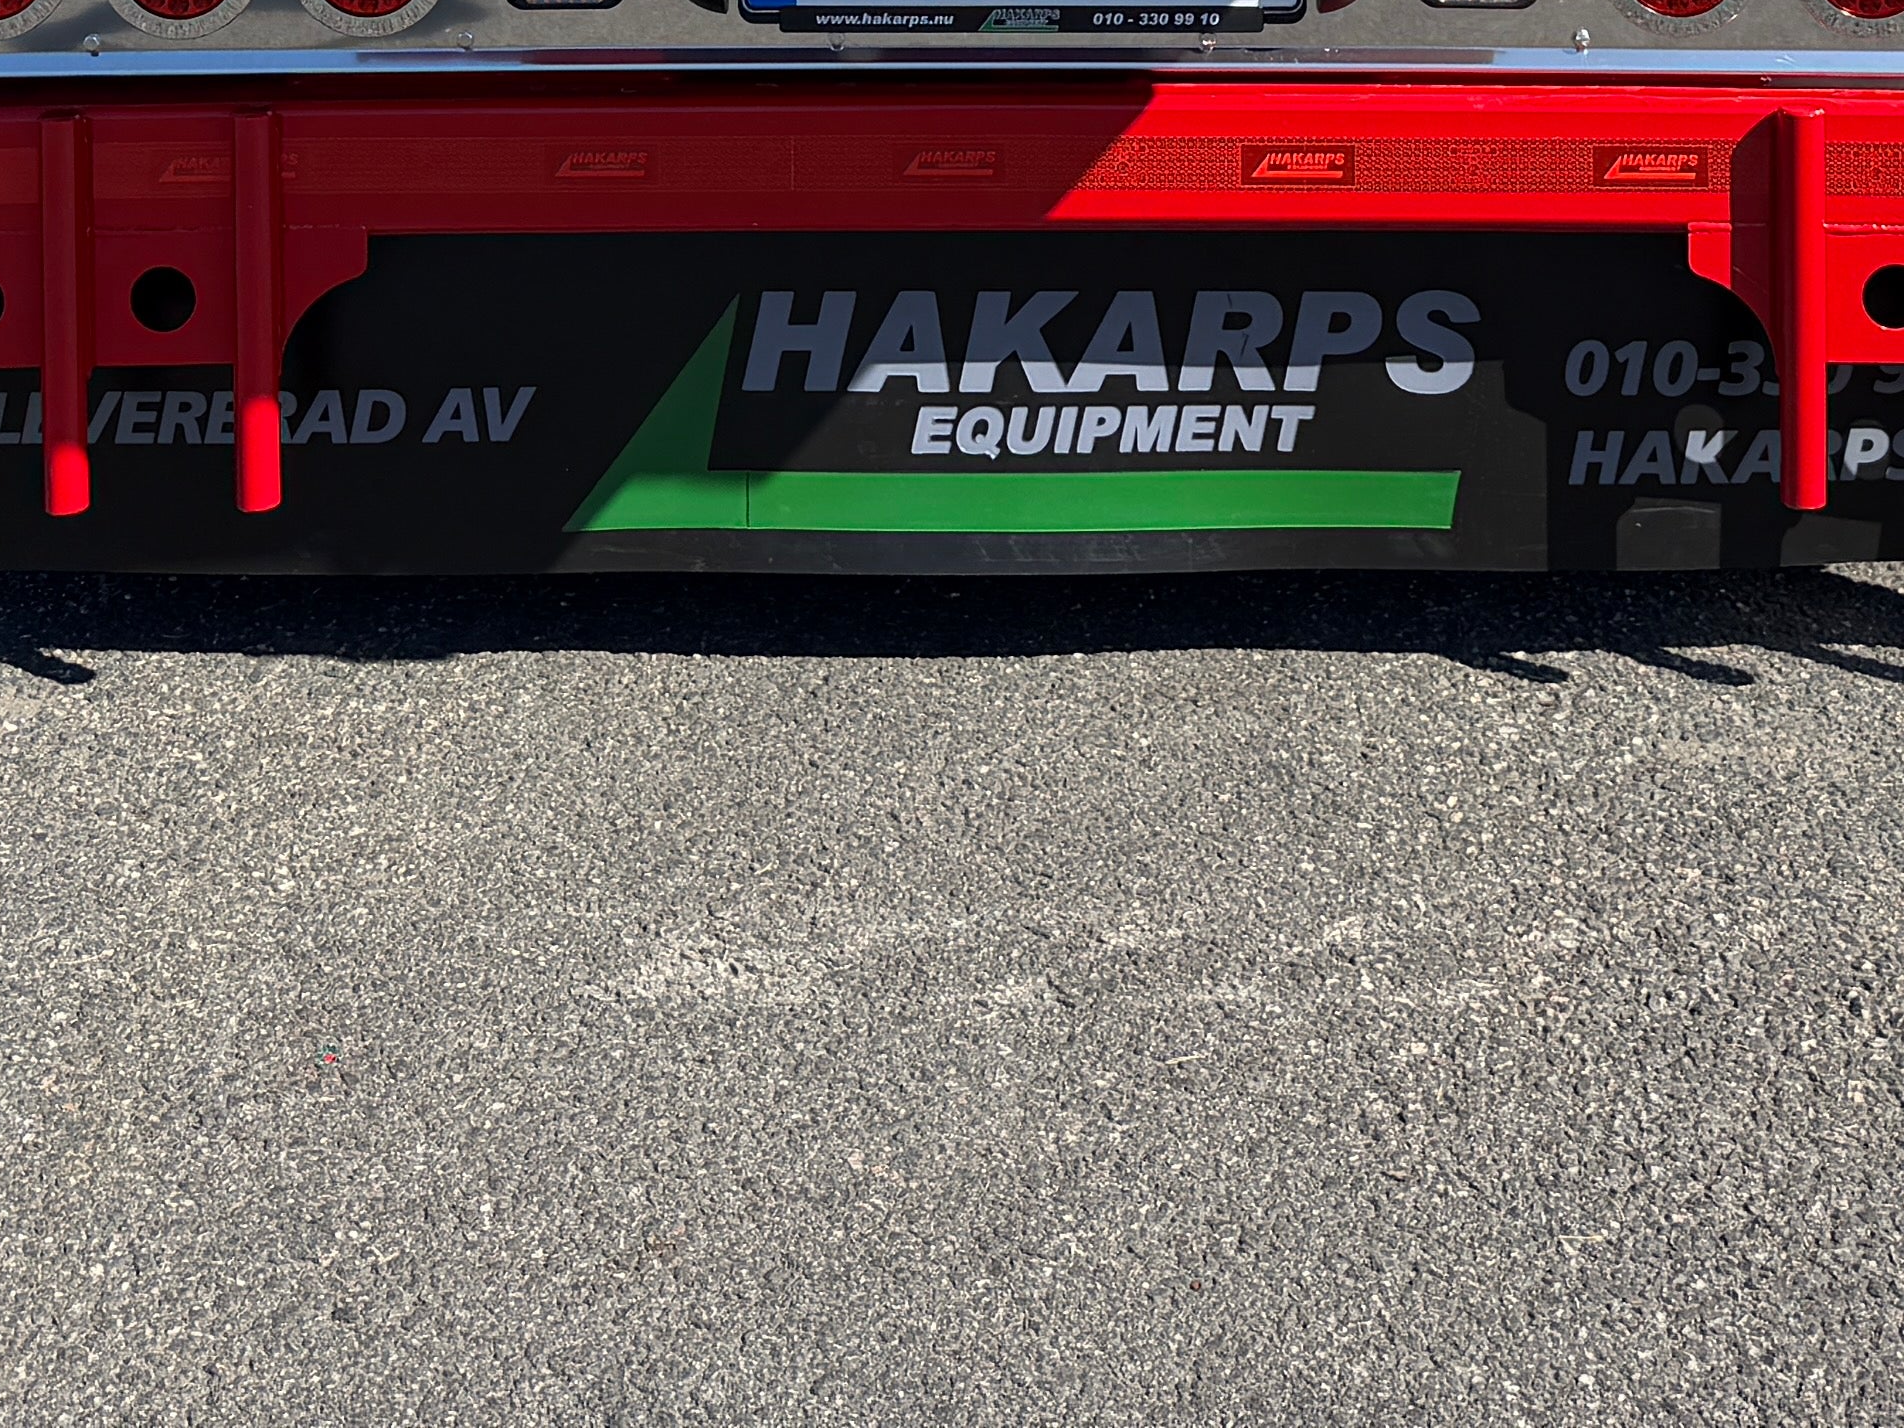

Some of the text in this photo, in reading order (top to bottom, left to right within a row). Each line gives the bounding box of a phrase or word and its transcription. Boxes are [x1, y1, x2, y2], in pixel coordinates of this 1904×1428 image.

[815, 12, 954, 28] www.hakarps.nu
[1092, 12, 1124, 26] 010
[1138, 12, 1169, 26] 330
[1174, 12, 1195, 26] 99
[1199, 12, 1221, 26] 10
[920, 151, 996, 163] HAKARPS
[1269, 153, 1345, 165] HAKARPS
[1622, 154, 1698, 166] HAKARPS
[741, 289, 1482, 394] HAKARPS
[422, 386, 537, 443] AV
[911, 405, 1315, 460] EQUIPMENT
